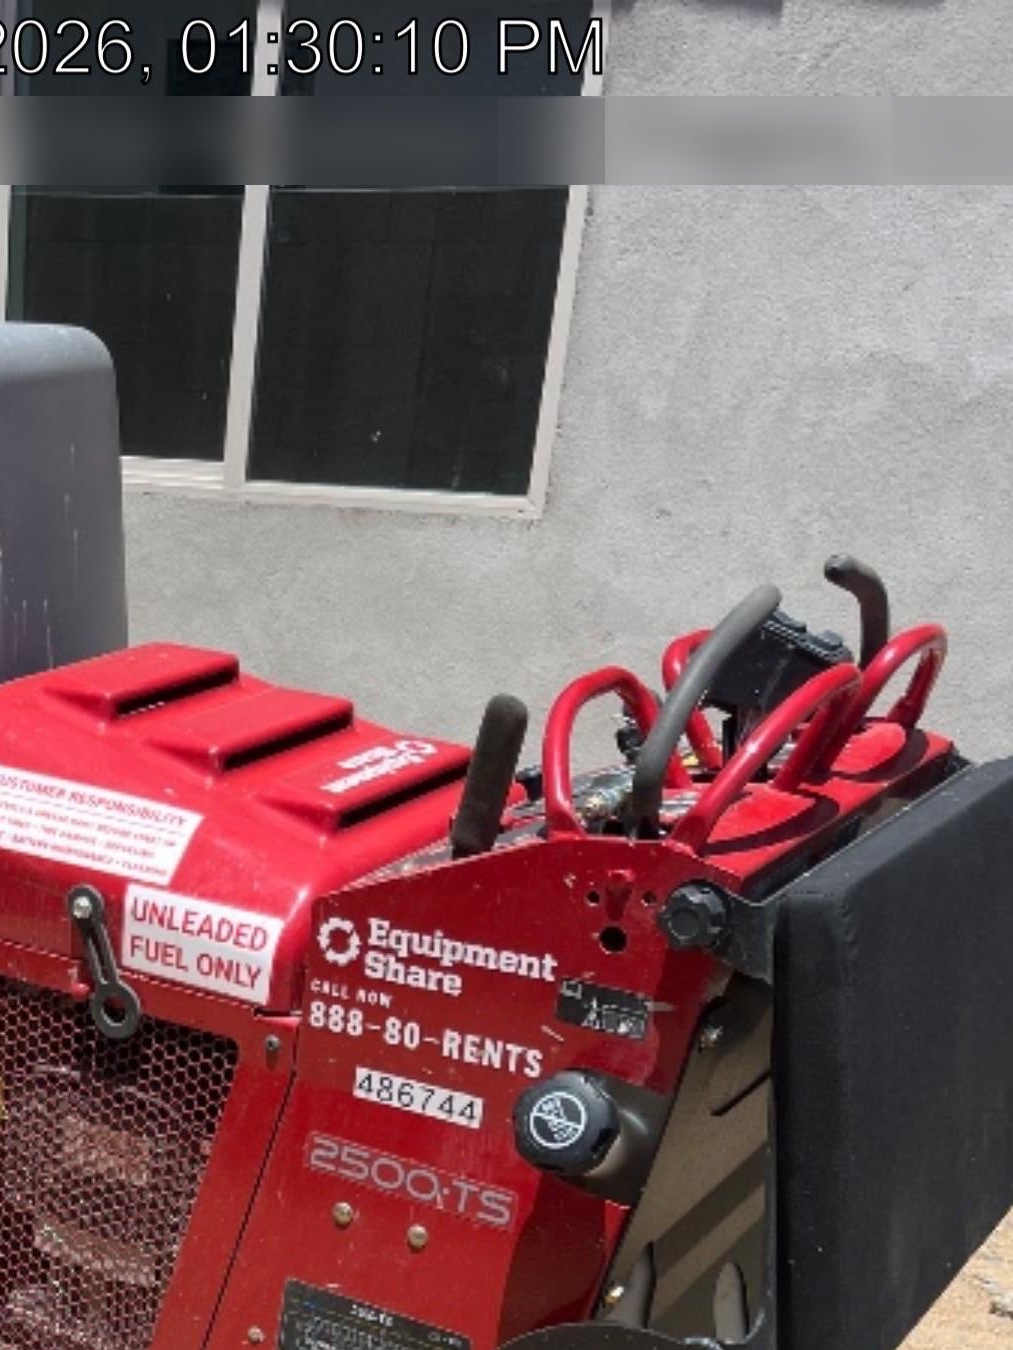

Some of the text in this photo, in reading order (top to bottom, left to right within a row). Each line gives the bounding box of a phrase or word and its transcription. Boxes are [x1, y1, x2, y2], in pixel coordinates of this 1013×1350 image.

[67, 789, 188, 826] RESPONSIBILITY
[131, 897, 269, 952] UNLEADED
[367, 917, 559, 982] Equipment
[129, 935, 262, 990] FUEL ONLY
[364, 950, 463, 997] Share
[310, 978, 393, 1008] CALL NOW
[309, 1000, 544, 1079] 888-80-RENTS
[357, 1073, 478, 1122] 486744
